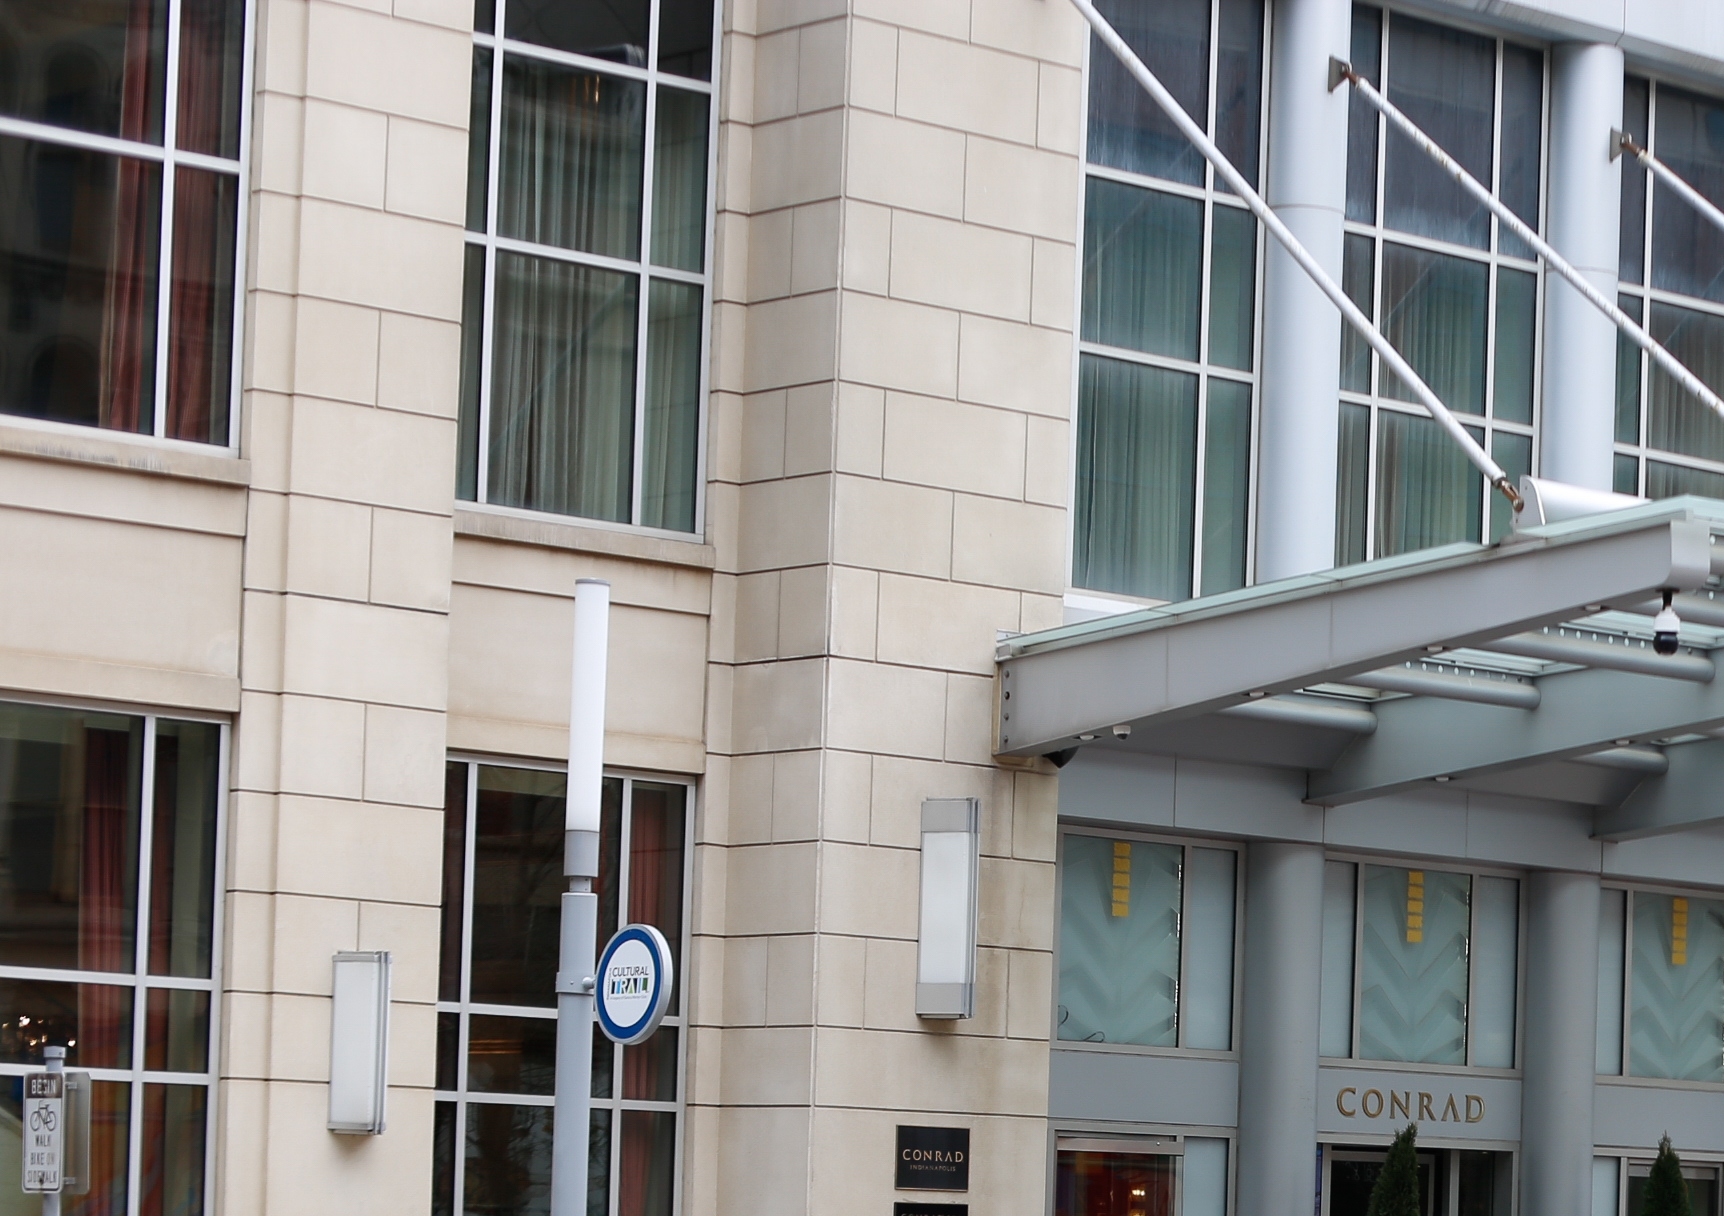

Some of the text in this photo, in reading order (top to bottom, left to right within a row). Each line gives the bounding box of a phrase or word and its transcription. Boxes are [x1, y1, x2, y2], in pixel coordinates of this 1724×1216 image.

[612, 966, 649, 977] CULTURAL
[610, 977, 649, 995] TRAIL
[31, 1079, 56, 1094] BEGIN
[1336, 1087, 1486, 1123] CONRAD
[35, 1134, 51, 1147] WALK
[902, 1149, 964, 1163] CONRAD
[909, 1164, 956, 1172] INDIANAPOLIS
